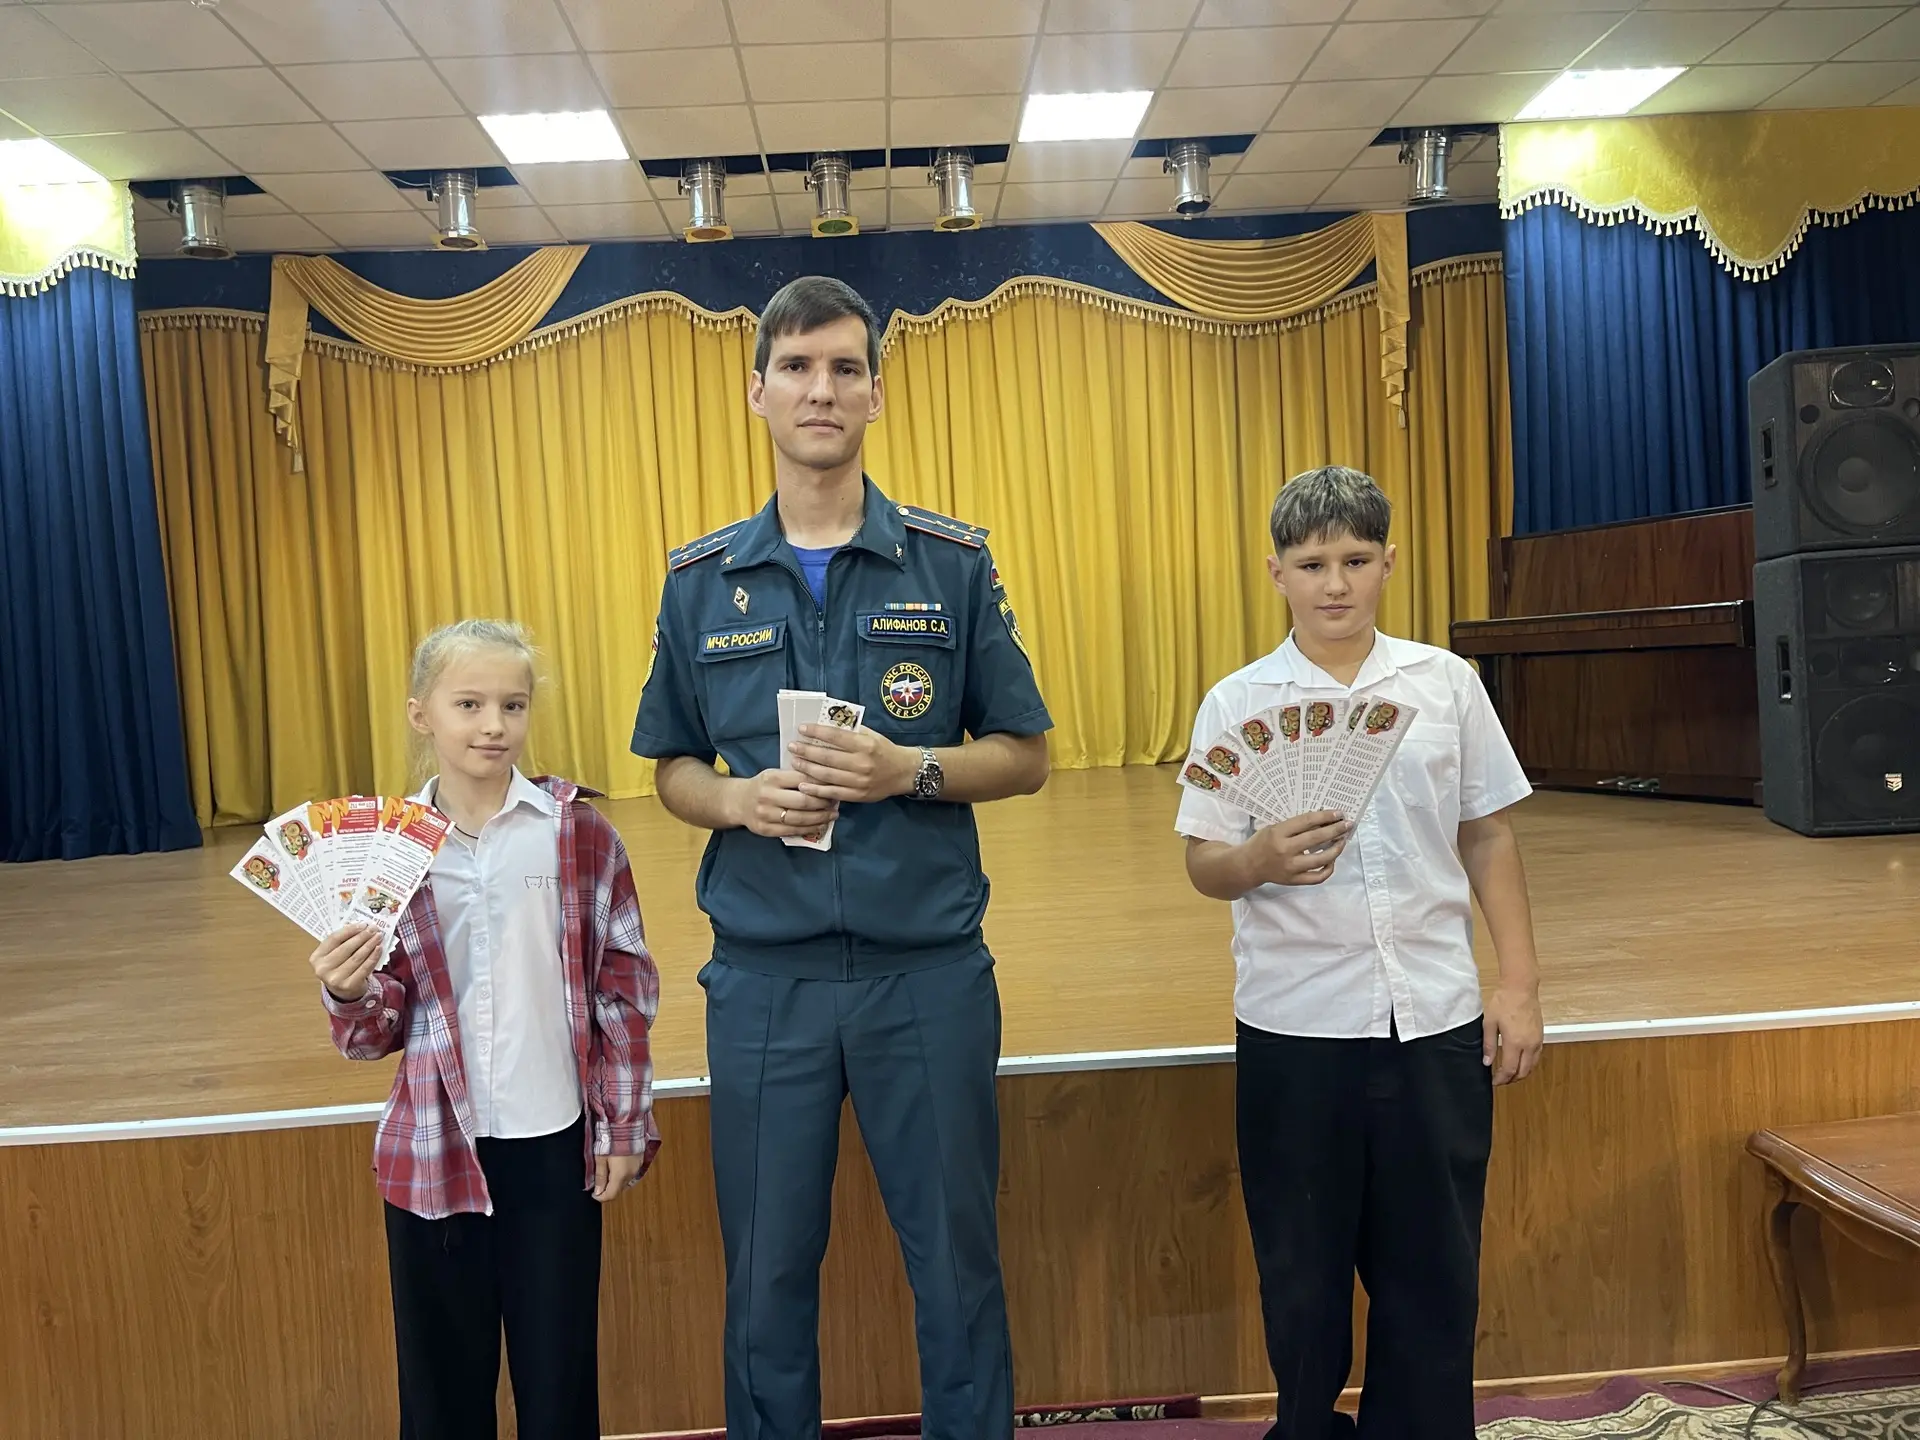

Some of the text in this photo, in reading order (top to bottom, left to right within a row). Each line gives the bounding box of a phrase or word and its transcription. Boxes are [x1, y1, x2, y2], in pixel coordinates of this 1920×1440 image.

[872, 618, 948, 634] АЛИФАНОВ С.А.
[706, 628, 773, 650] МЧС РОССИИ
[883, 664, 931, 689] МЧС РОССИИ
[884, 694, 931, 717] EMERCOM
